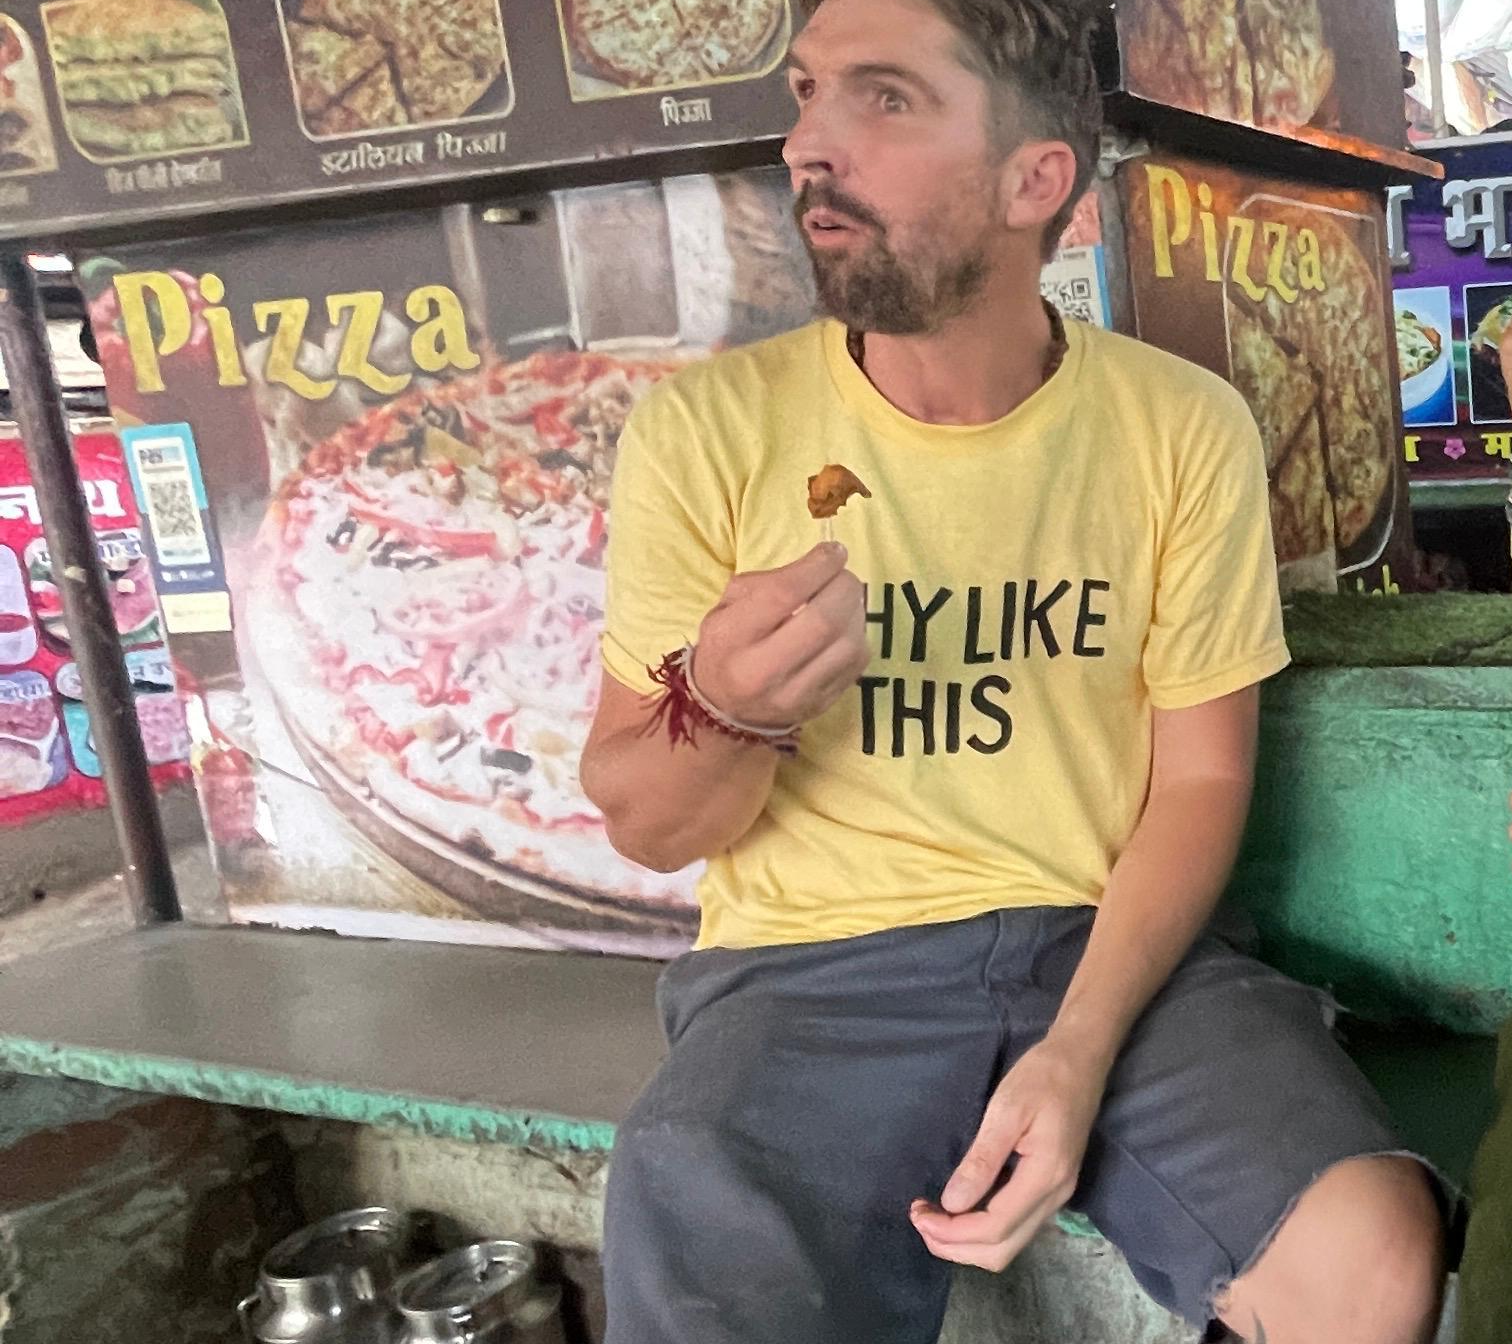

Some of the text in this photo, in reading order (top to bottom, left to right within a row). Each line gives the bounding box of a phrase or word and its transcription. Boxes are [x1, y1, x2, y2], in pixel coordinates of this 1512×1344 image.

[1144, 164, 1325, 303] Pizza
[113, 269, 480, 400] Pizza
[863, 579, 1110, 664] HY LIKE
[857, 675, 1013, 758] THIS
